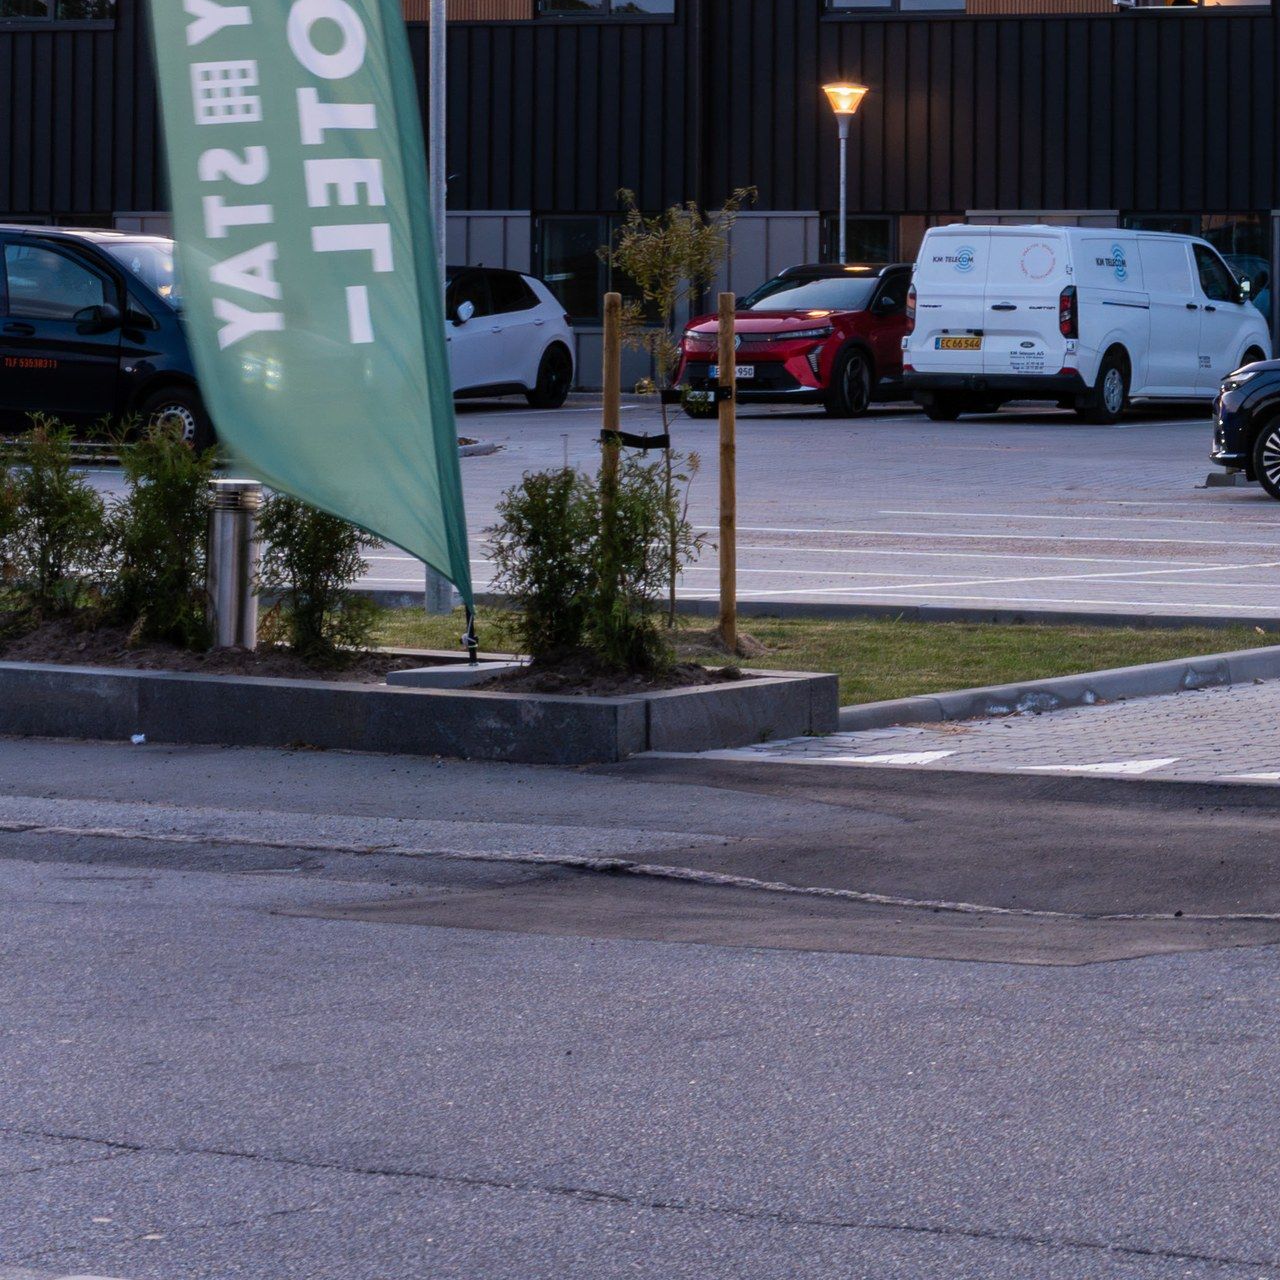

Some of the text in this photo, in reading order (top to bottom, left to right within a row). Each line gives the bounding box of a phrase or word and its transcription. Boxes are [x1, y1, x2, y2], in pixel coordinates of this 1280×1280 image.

[944, 255, 974, 264] TELECOM
[940, 339, 980, 349] EC 66 544
